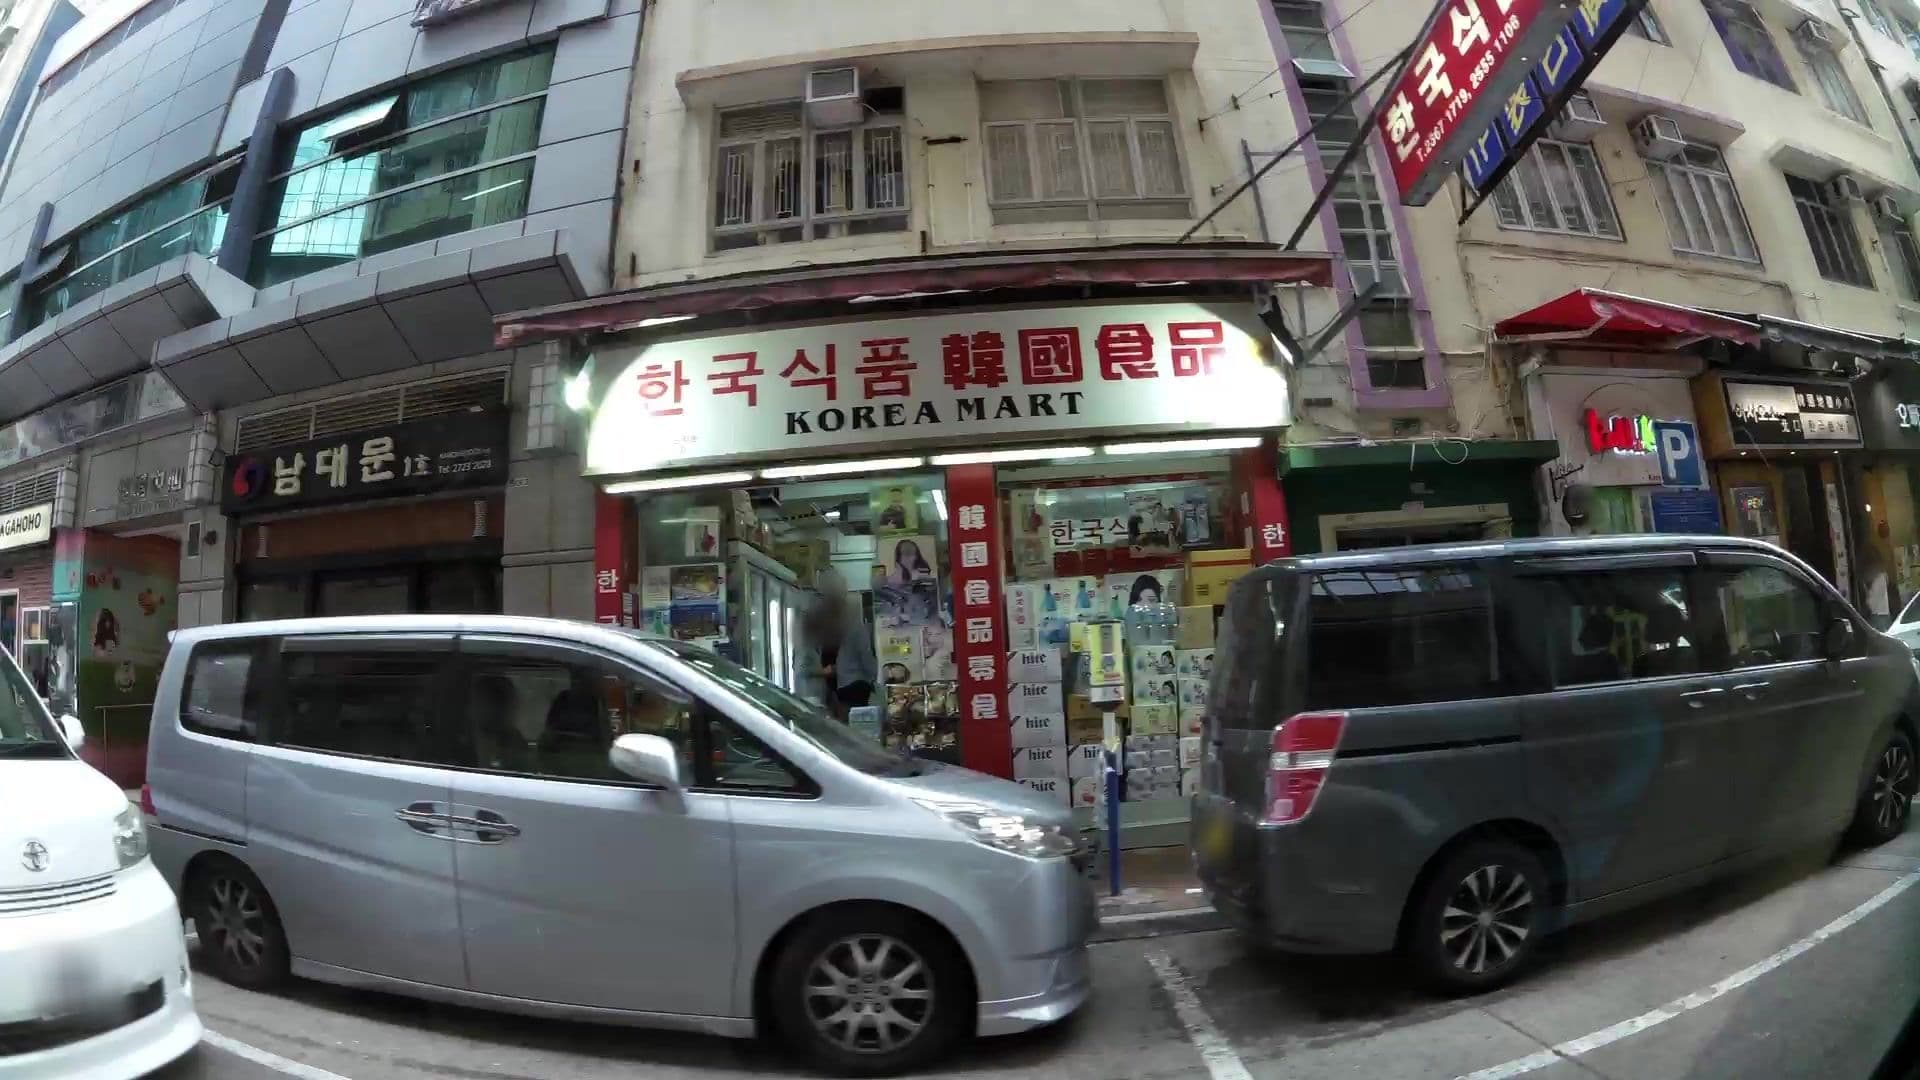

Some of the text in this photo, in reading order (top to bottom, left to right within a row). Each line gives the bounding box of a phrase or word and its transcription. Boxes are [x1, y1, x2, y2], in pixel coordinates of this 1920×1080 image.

[1469, 50, 1496, 88] 2555
[942, 320, 1226, 391] 韓國食品
[637, 337, 918, 418] 한국식품
[785, 390, 1084, 435] KOREA MART
[271, 436, 397, 496] 남대문
[1661, 428, 1690, 480] P
[1261, 523, 1285, 548] 한
[1022, 653, 1047, 665] hite
[1023, 684, 1048, 696] hite
[1025, 716, 1050, 729] hite
[1028, 749, 1053, 761] hite
